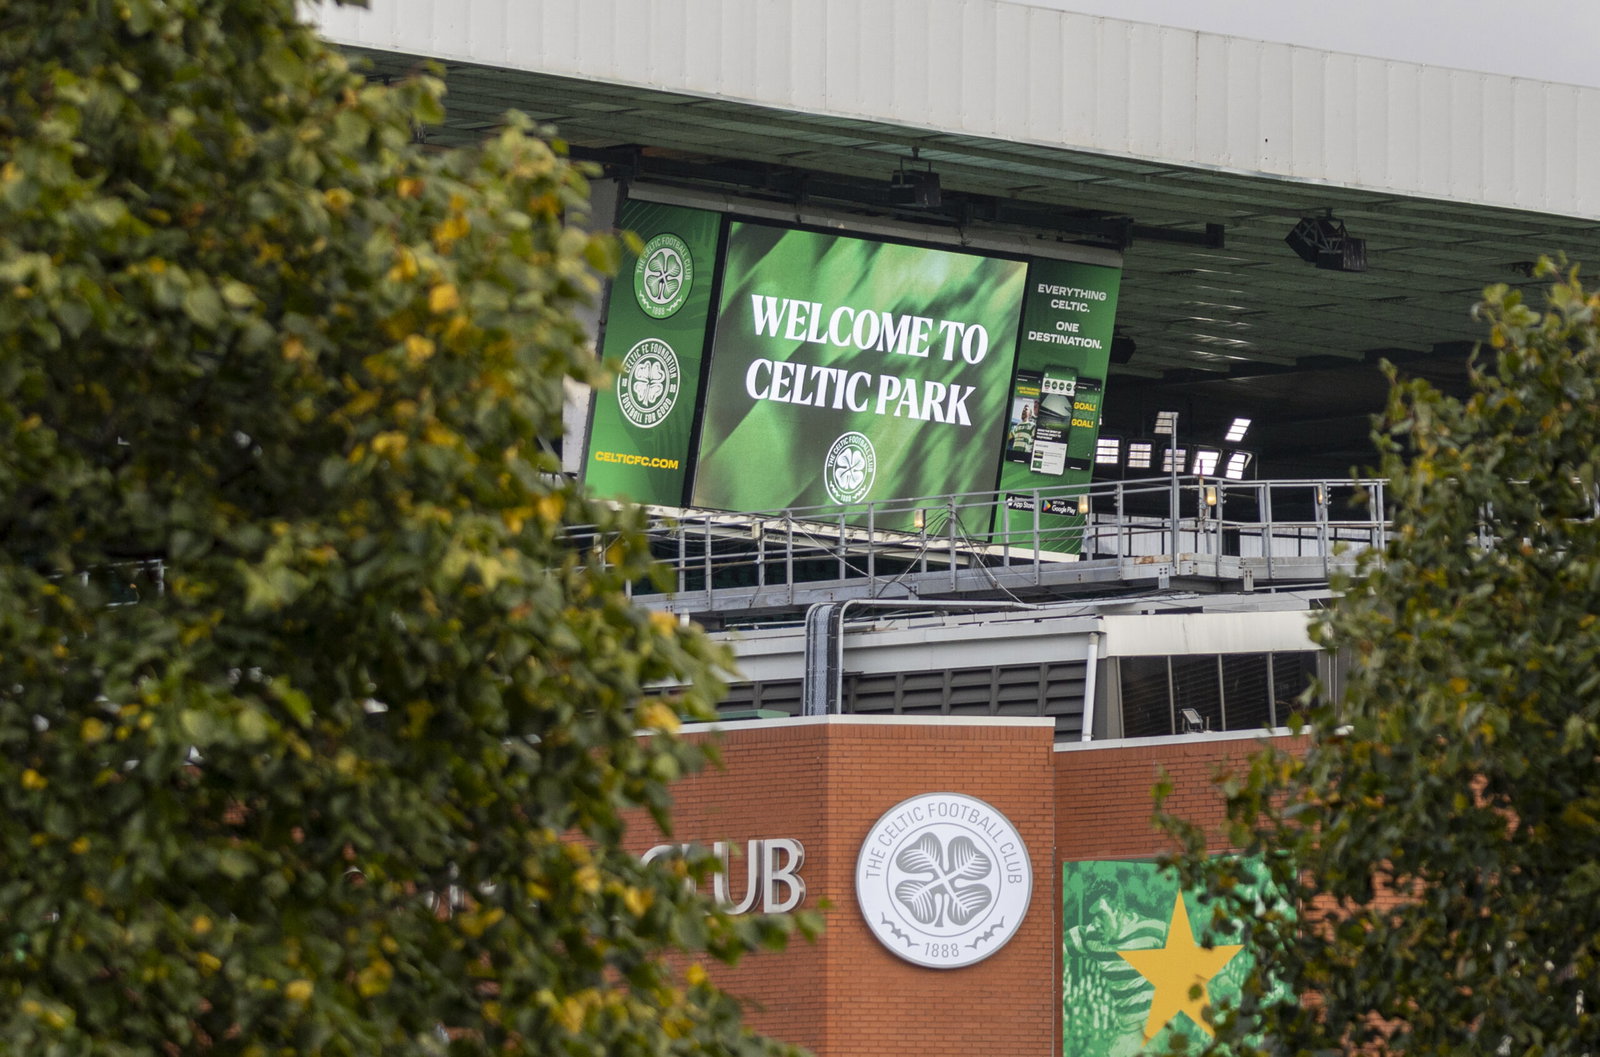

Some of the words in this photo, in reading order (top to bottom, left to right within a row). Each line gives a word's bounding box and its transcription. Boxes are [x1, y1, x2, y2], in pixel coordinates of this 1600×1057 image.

[661, 236, 688, 258] FOOTBALL
[1037, 284, 1107, 302] EVERYTHING
[1050, 298, 1090, 314] CELTIC.
[751, 294, 933, 358] WELCOME
[938, 320, 989, 366] TO
[1056, 321, 1080, 333] ONE
[1028, 330, 1102, 350] DESTINATION.
[624, 348, 642, 374] CELTIC
[642, 343, 650, 354] FC
[746, 358, 872, 412] CELTIC
[875, 374, 976, 426] PARK
[1074, 402, 1096, 412] GOAL!
[1071, 418, 1094, 428] GOAL!
[594, 450, 678, 470] CELTICFC.COM
[828, 452, 836, 468] THE
[833, 438, 848, 454] CELTIC
[848, 436, 870, 454] FOOTBALL
[1052, 504, 1066, 514] Google
[1067, 506, 1076, 515] Play
[866, 848, 886, 878] THE
[878, 806, 924, 845] CELTIC
[928, 802, 1004, 844] FOOTBALL
[999, 843, 1022, 884] CLUB
[640, 839, 806, 922] UB
[924, 942, 960, 958] 1888
